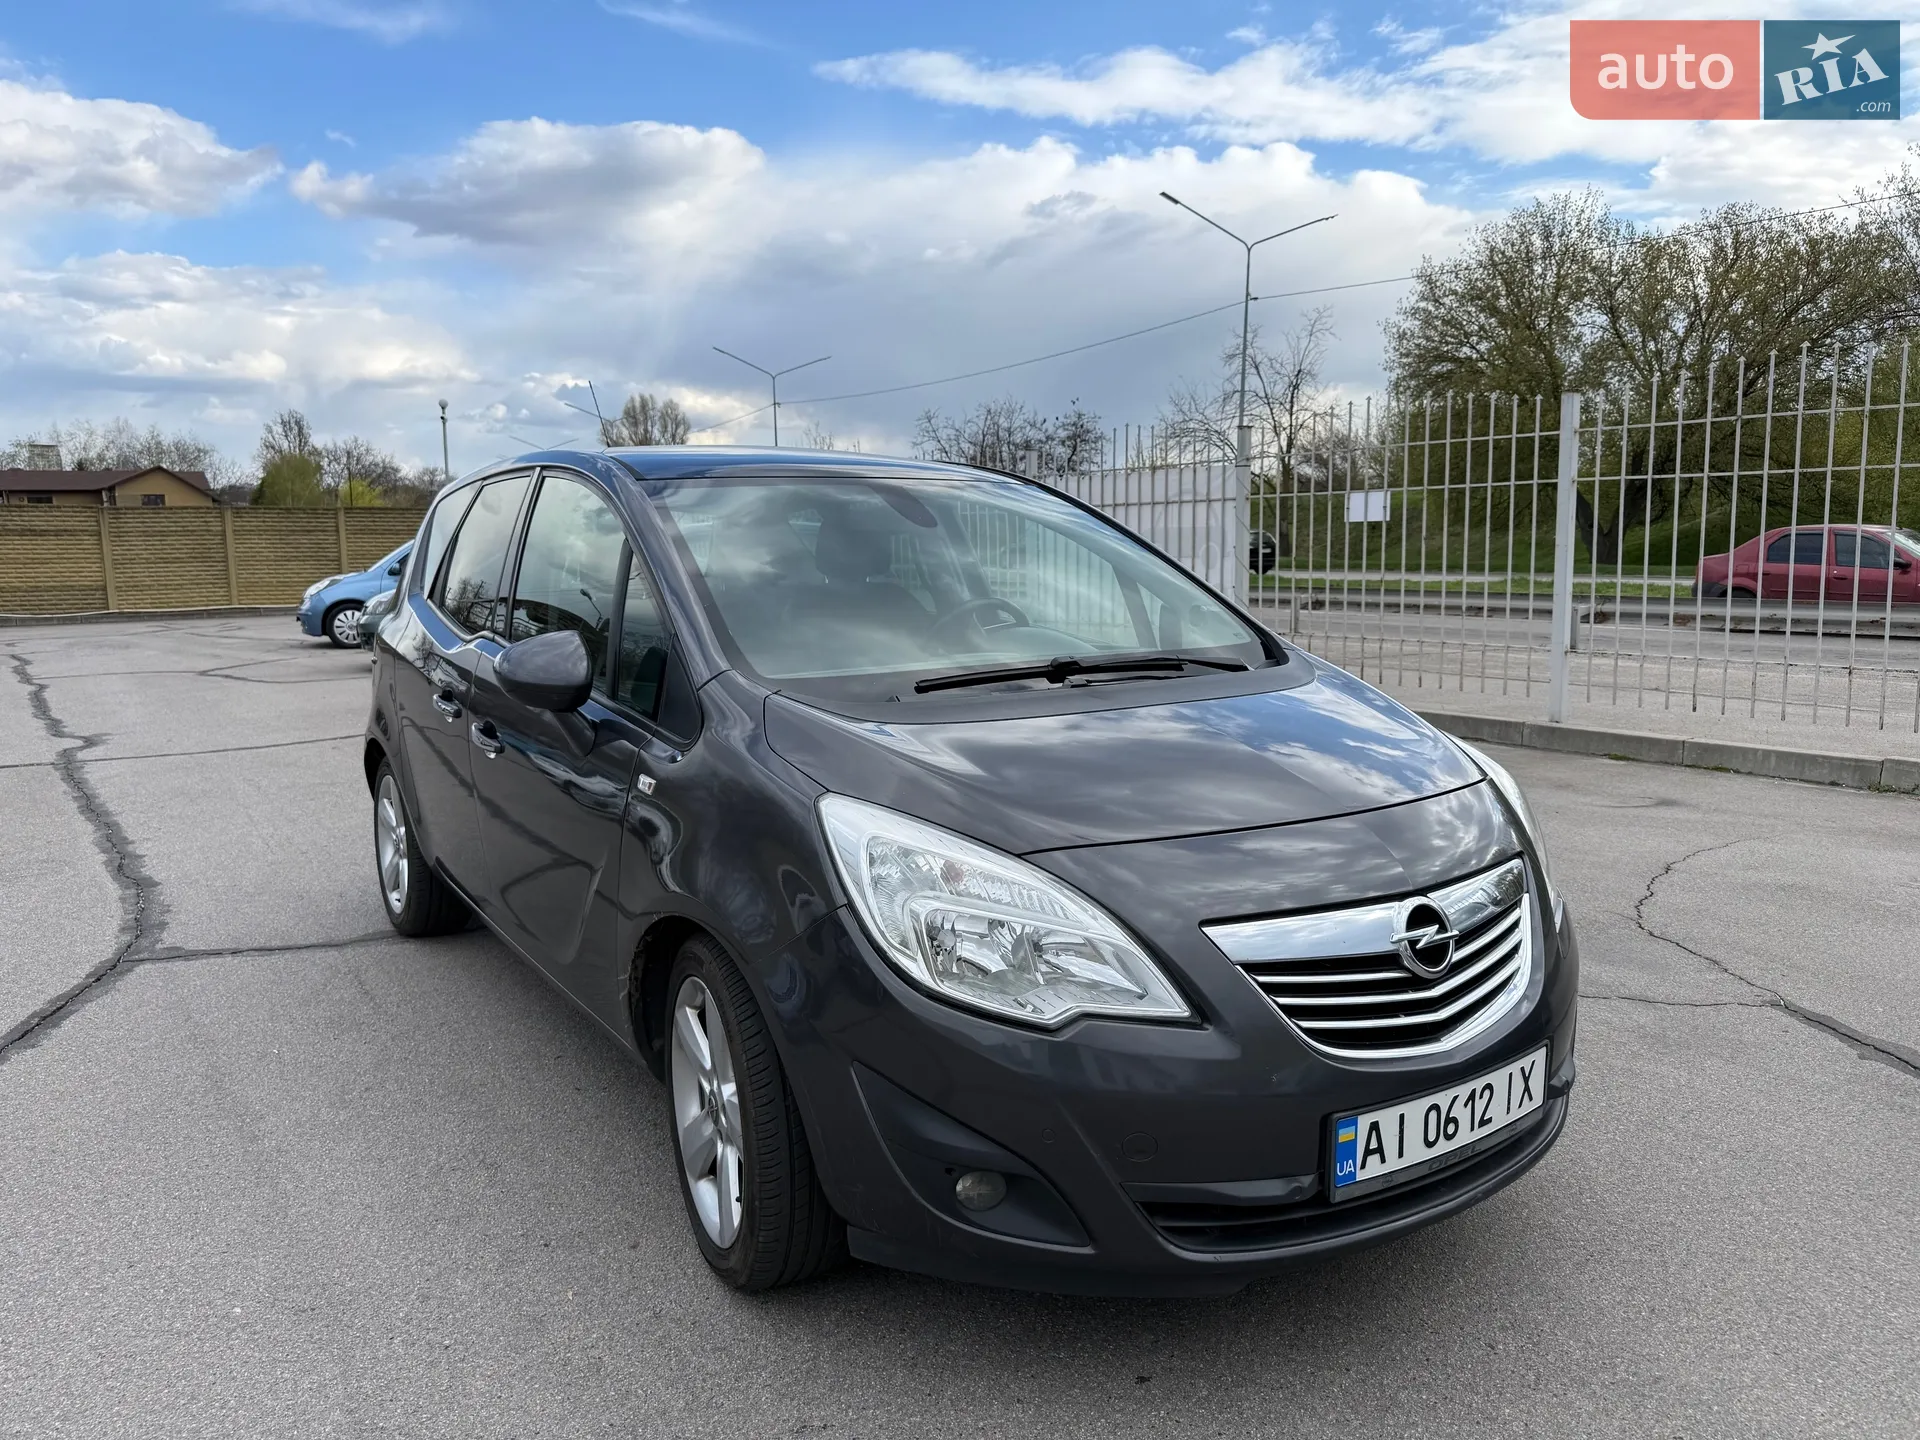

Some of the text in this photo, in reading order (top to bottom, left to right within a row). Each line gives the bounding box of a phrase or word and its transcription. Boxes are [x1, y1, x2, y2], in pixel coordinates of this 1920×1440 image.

[1359, 1059, 1536, 1170] AI 0612 IX
[1337, 1159, 1355, 1176] UA
[1428, 1145, 1482, 1171] OPEL
